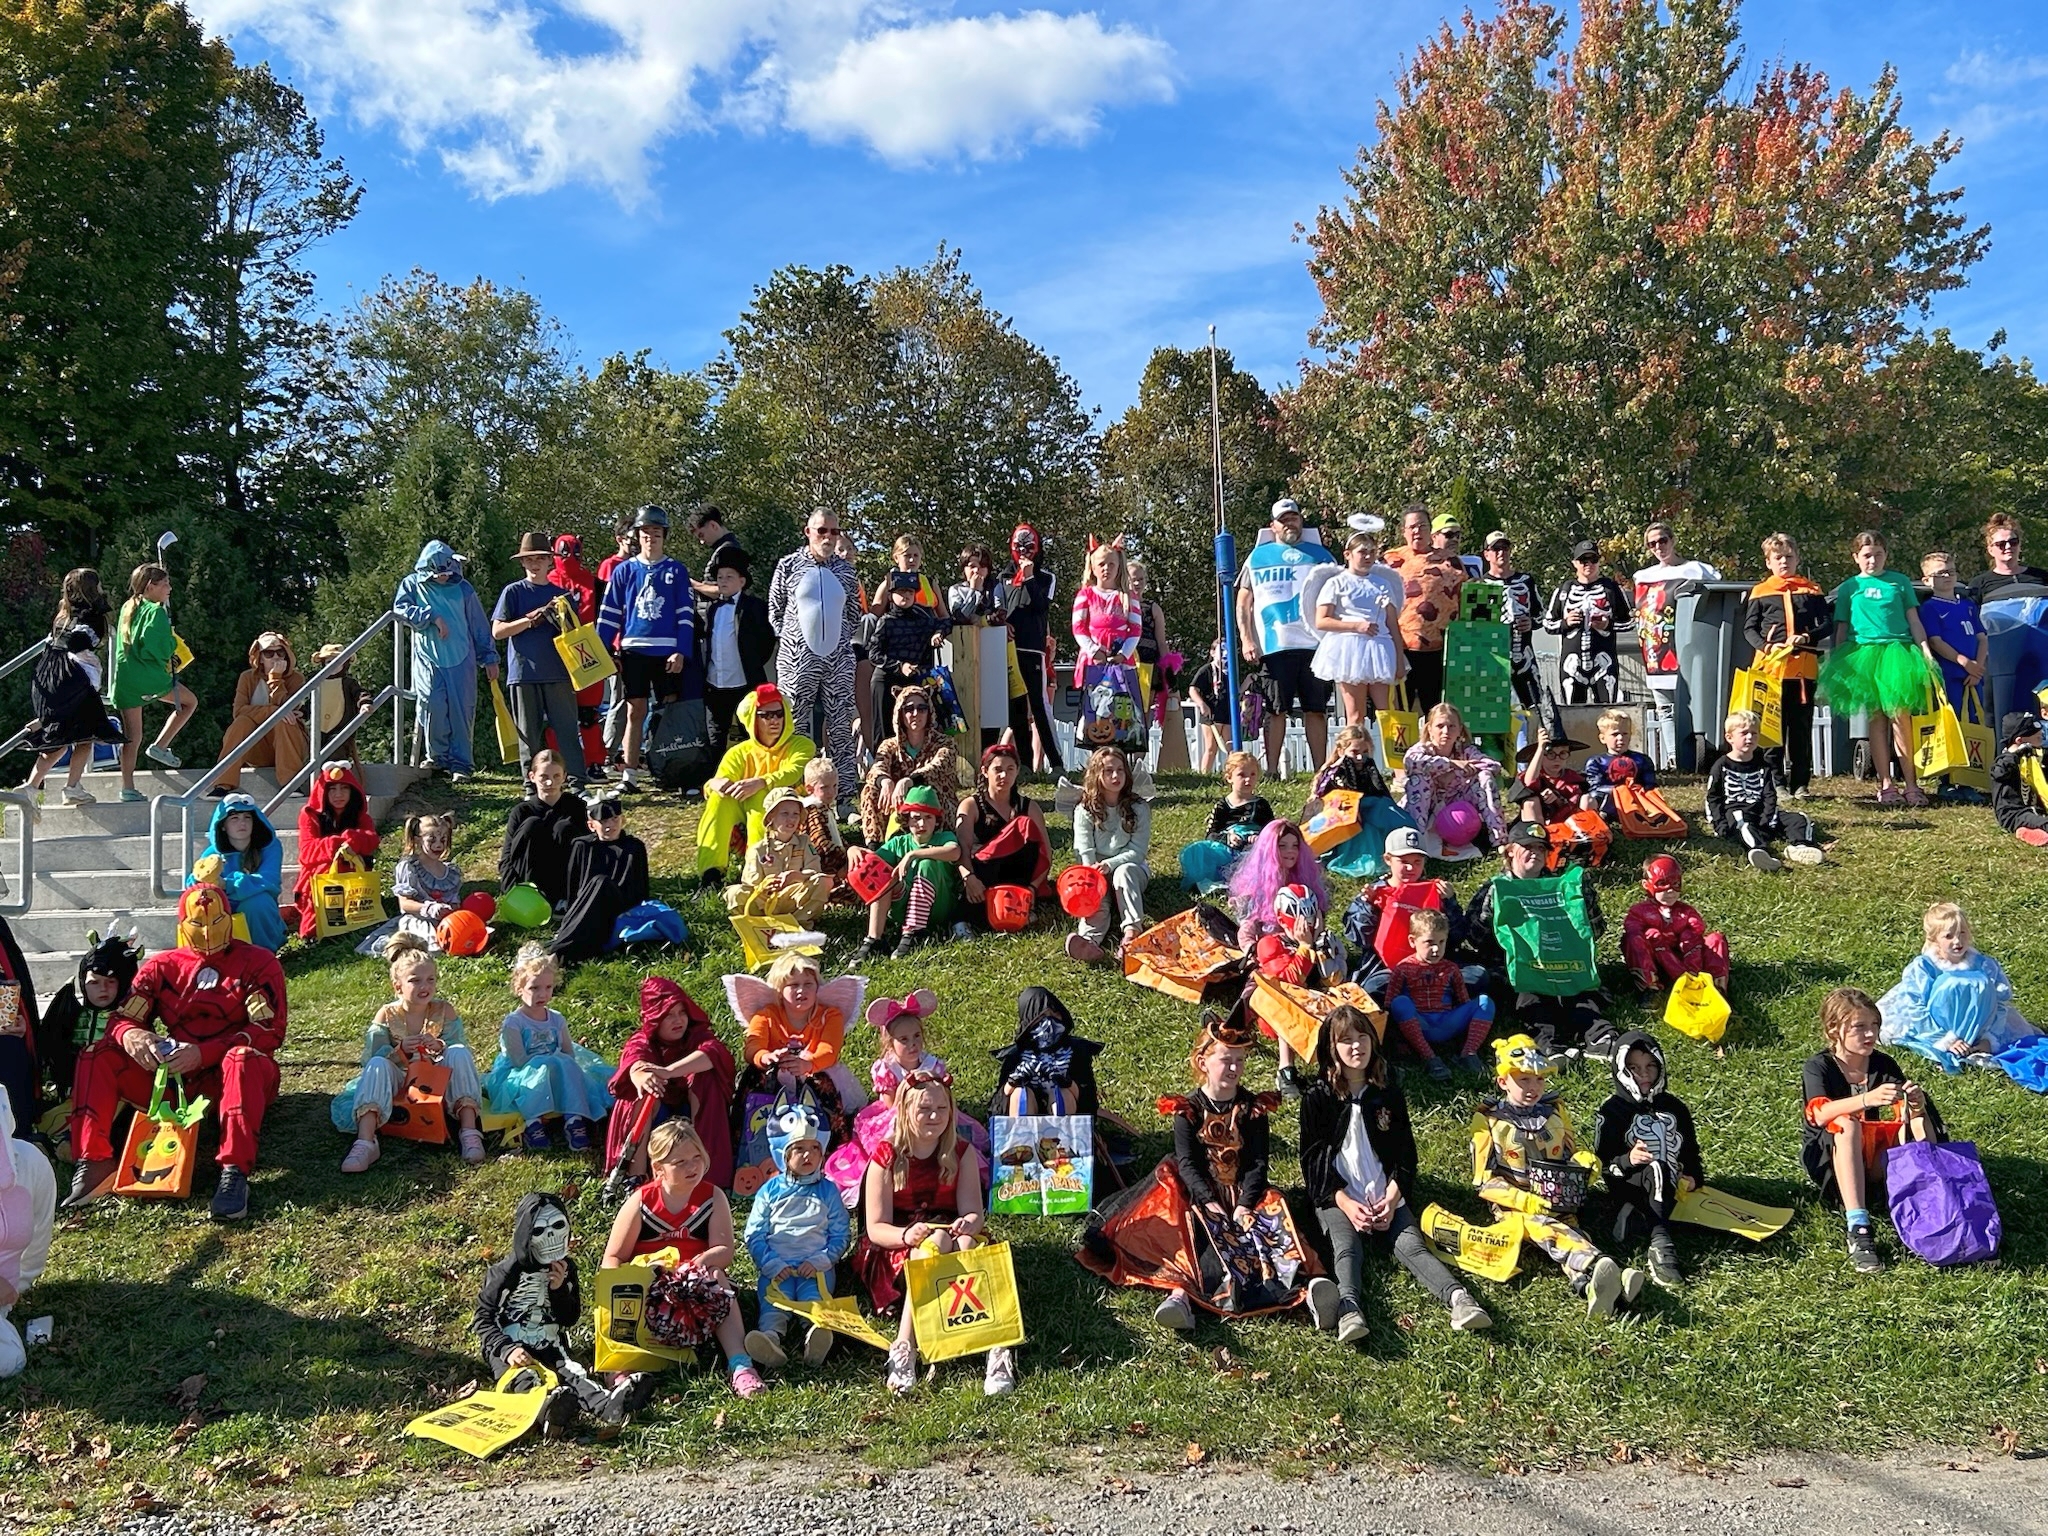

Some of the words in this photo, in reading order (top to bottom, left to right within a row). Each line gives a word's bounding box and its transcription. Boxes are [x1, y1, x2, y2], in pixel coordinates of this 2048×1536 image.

[664, 572, 674, 584] C
[1254, 567, 1297, 587] Milk
[1960, 620, 1975, 635] 10
[655, 737, 705, 757] Hallmark
[1467, 1234, 1483, 1243] FOR
[1485, 1237, 1509, 1248] THAT!
[947, 1311, 990, 1327] KOA
